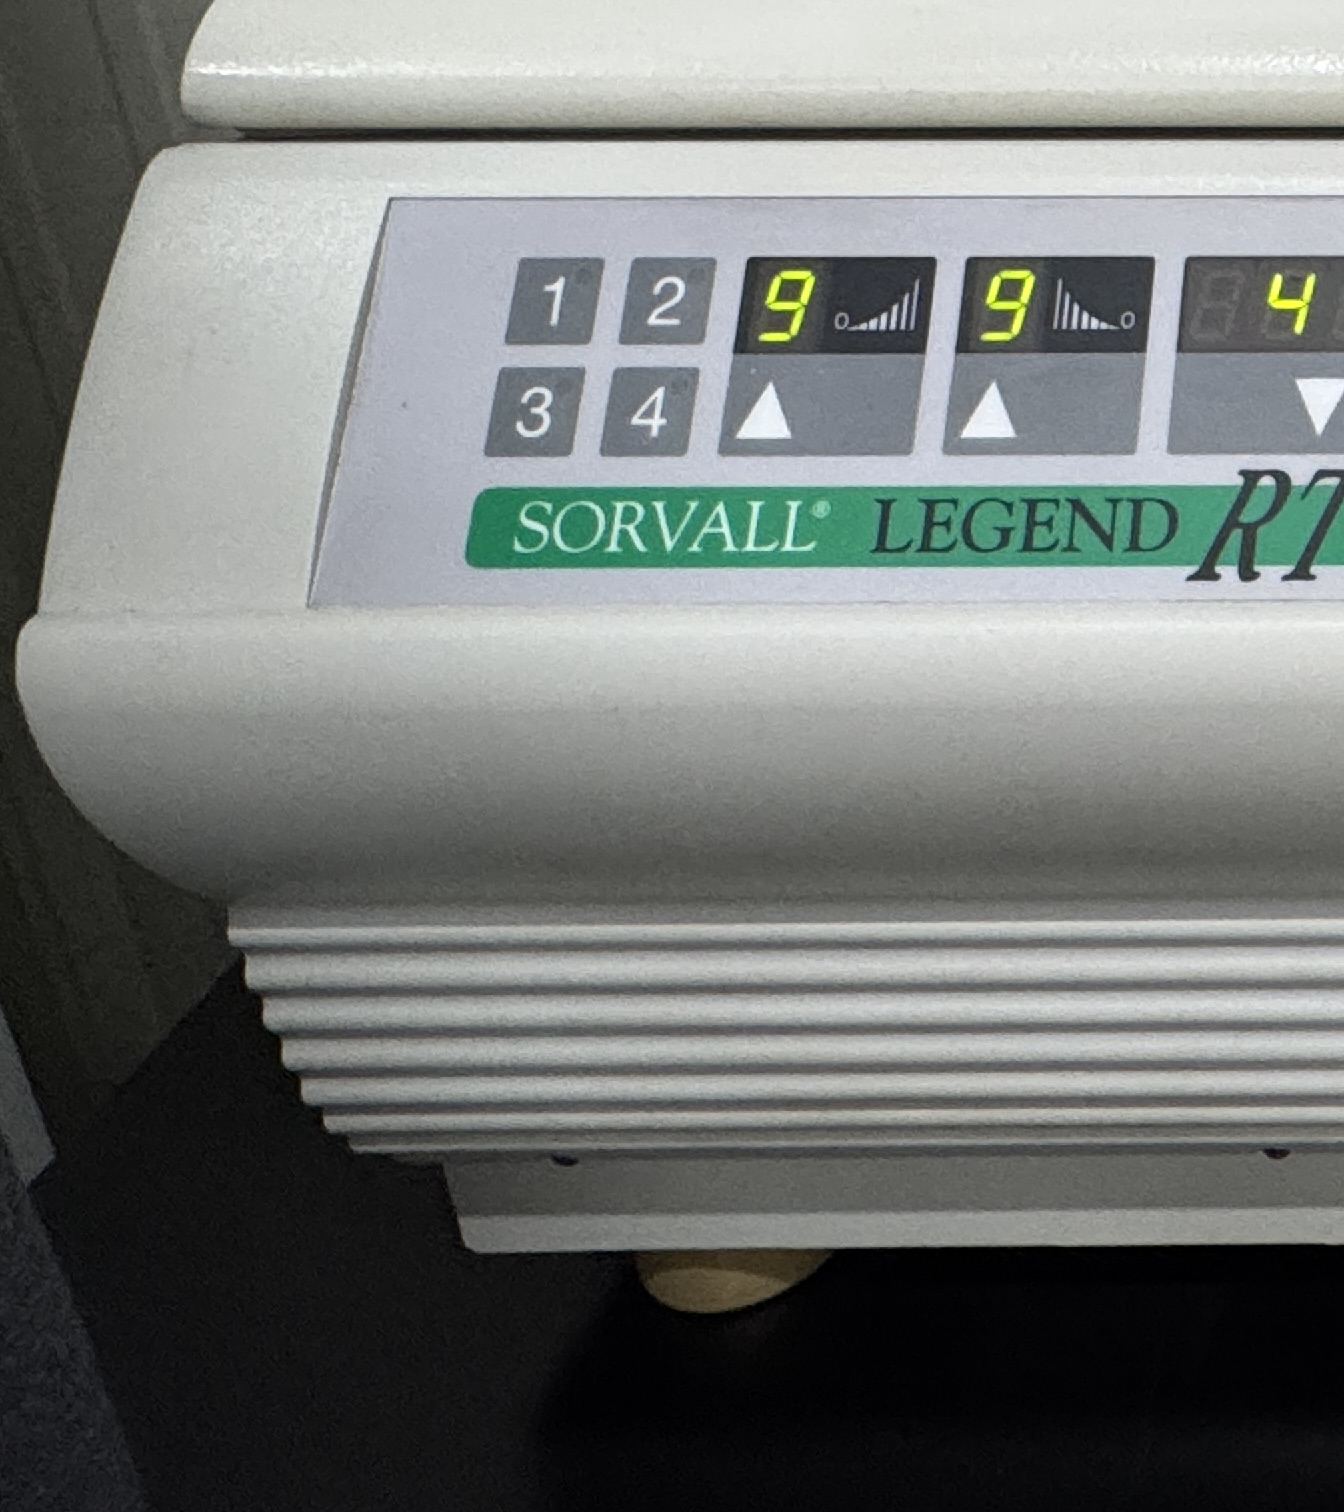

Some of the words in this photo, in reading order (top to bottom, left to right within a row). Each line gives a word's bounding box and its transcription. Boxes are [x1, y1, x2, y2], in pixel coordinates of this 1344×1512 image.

[543, 276, 566, 326] 1
[646, 276, 687, 327] 2
[758, 269, 816, 342] 9
[979, 269, 1035, 342] 9
[514, 386, 552, 438] 3
[630, 386, 668, 438] 4
[869, 496, 1180, 555] LEGEND
